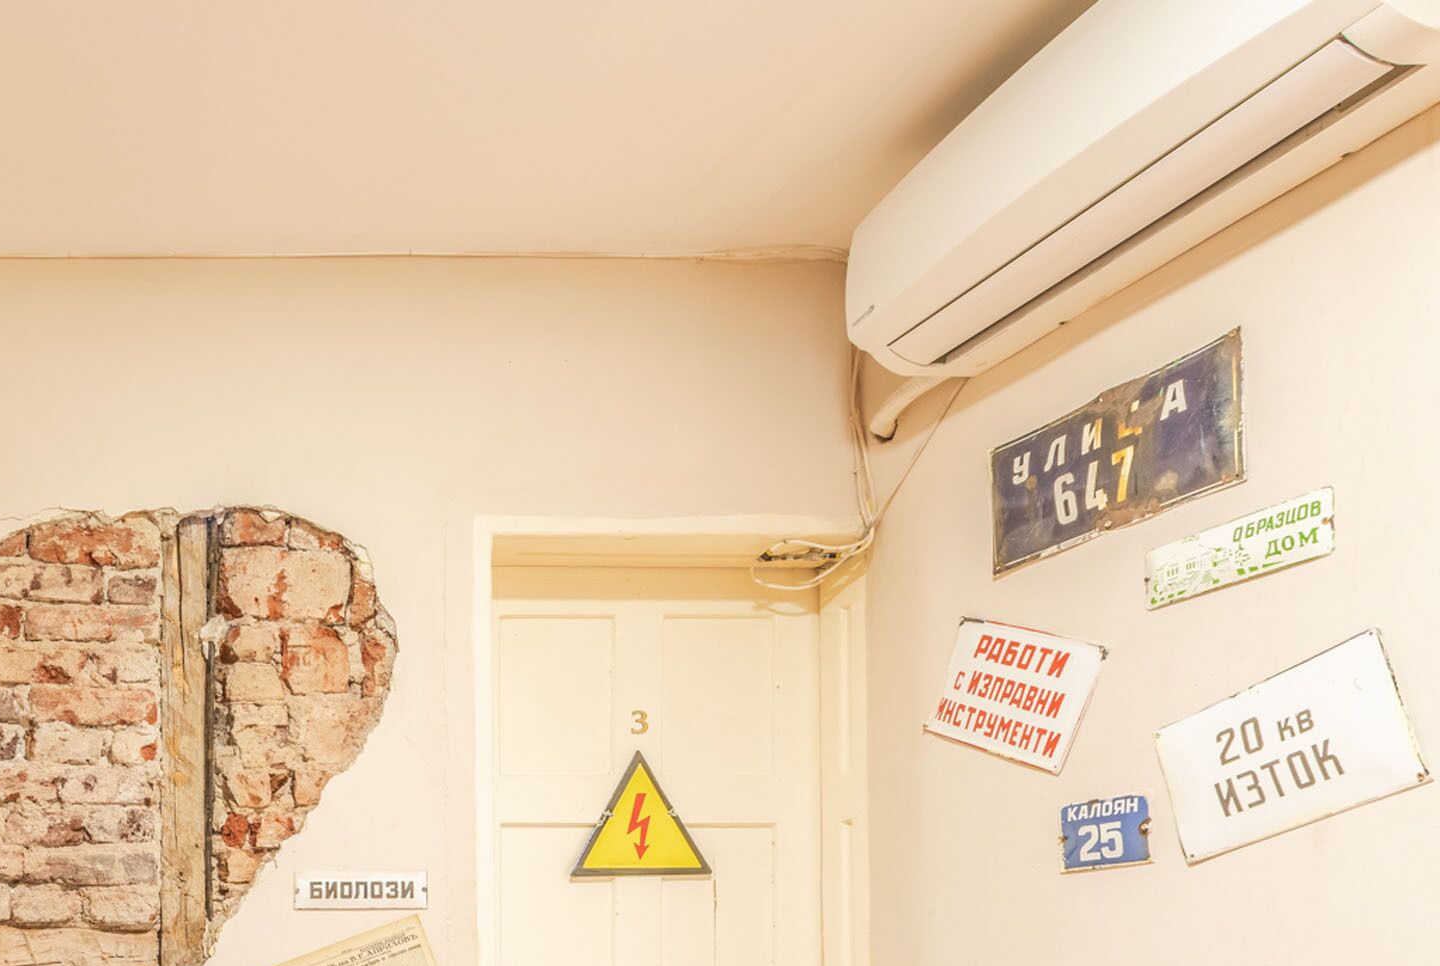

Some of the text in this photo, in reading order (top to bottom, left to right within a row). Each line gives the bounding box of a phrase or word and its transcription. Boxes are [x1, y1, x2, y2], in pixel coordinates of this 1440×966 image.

[1053, 444, 1135, 526] 647
[1232, 500, 1321, 543] ОБРАЗЦОВ
[1264, 527, 1320, 559] ДОМ
[973, 634, 1071, 678] РАБОТИ
[967, 670, 1066, 719] ИЗПРАВНИ
[631, 710, 649, 735] 3
[935, 697, 1061, 758] ИНСТРУМЕНТИ
[1216, 717, 1264, 766] 20
[1214, 738, 1345, 818] ИЗТОК
[1067, 797, 1139, 823] КАЛОЯН
[1079, 821, 1124, 861] 25
[310, 881, 414, 899] БИОЛОЗИ
